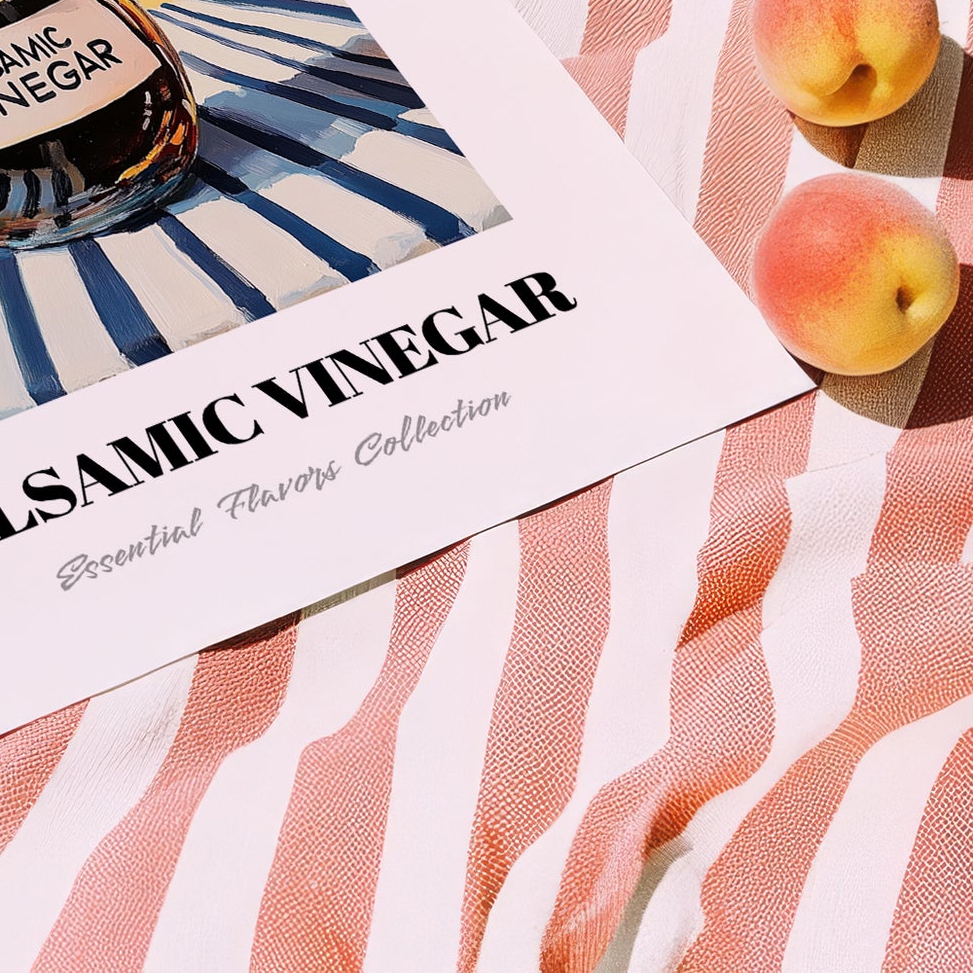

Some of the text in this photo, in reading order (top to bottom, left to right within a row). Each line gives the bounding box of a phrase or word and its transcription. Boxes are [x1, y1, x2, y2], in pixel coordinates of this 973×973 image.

[251, 270, 578, 420] VINEGAR
[56, 390, 512, 591] Essential Flavors Collection
